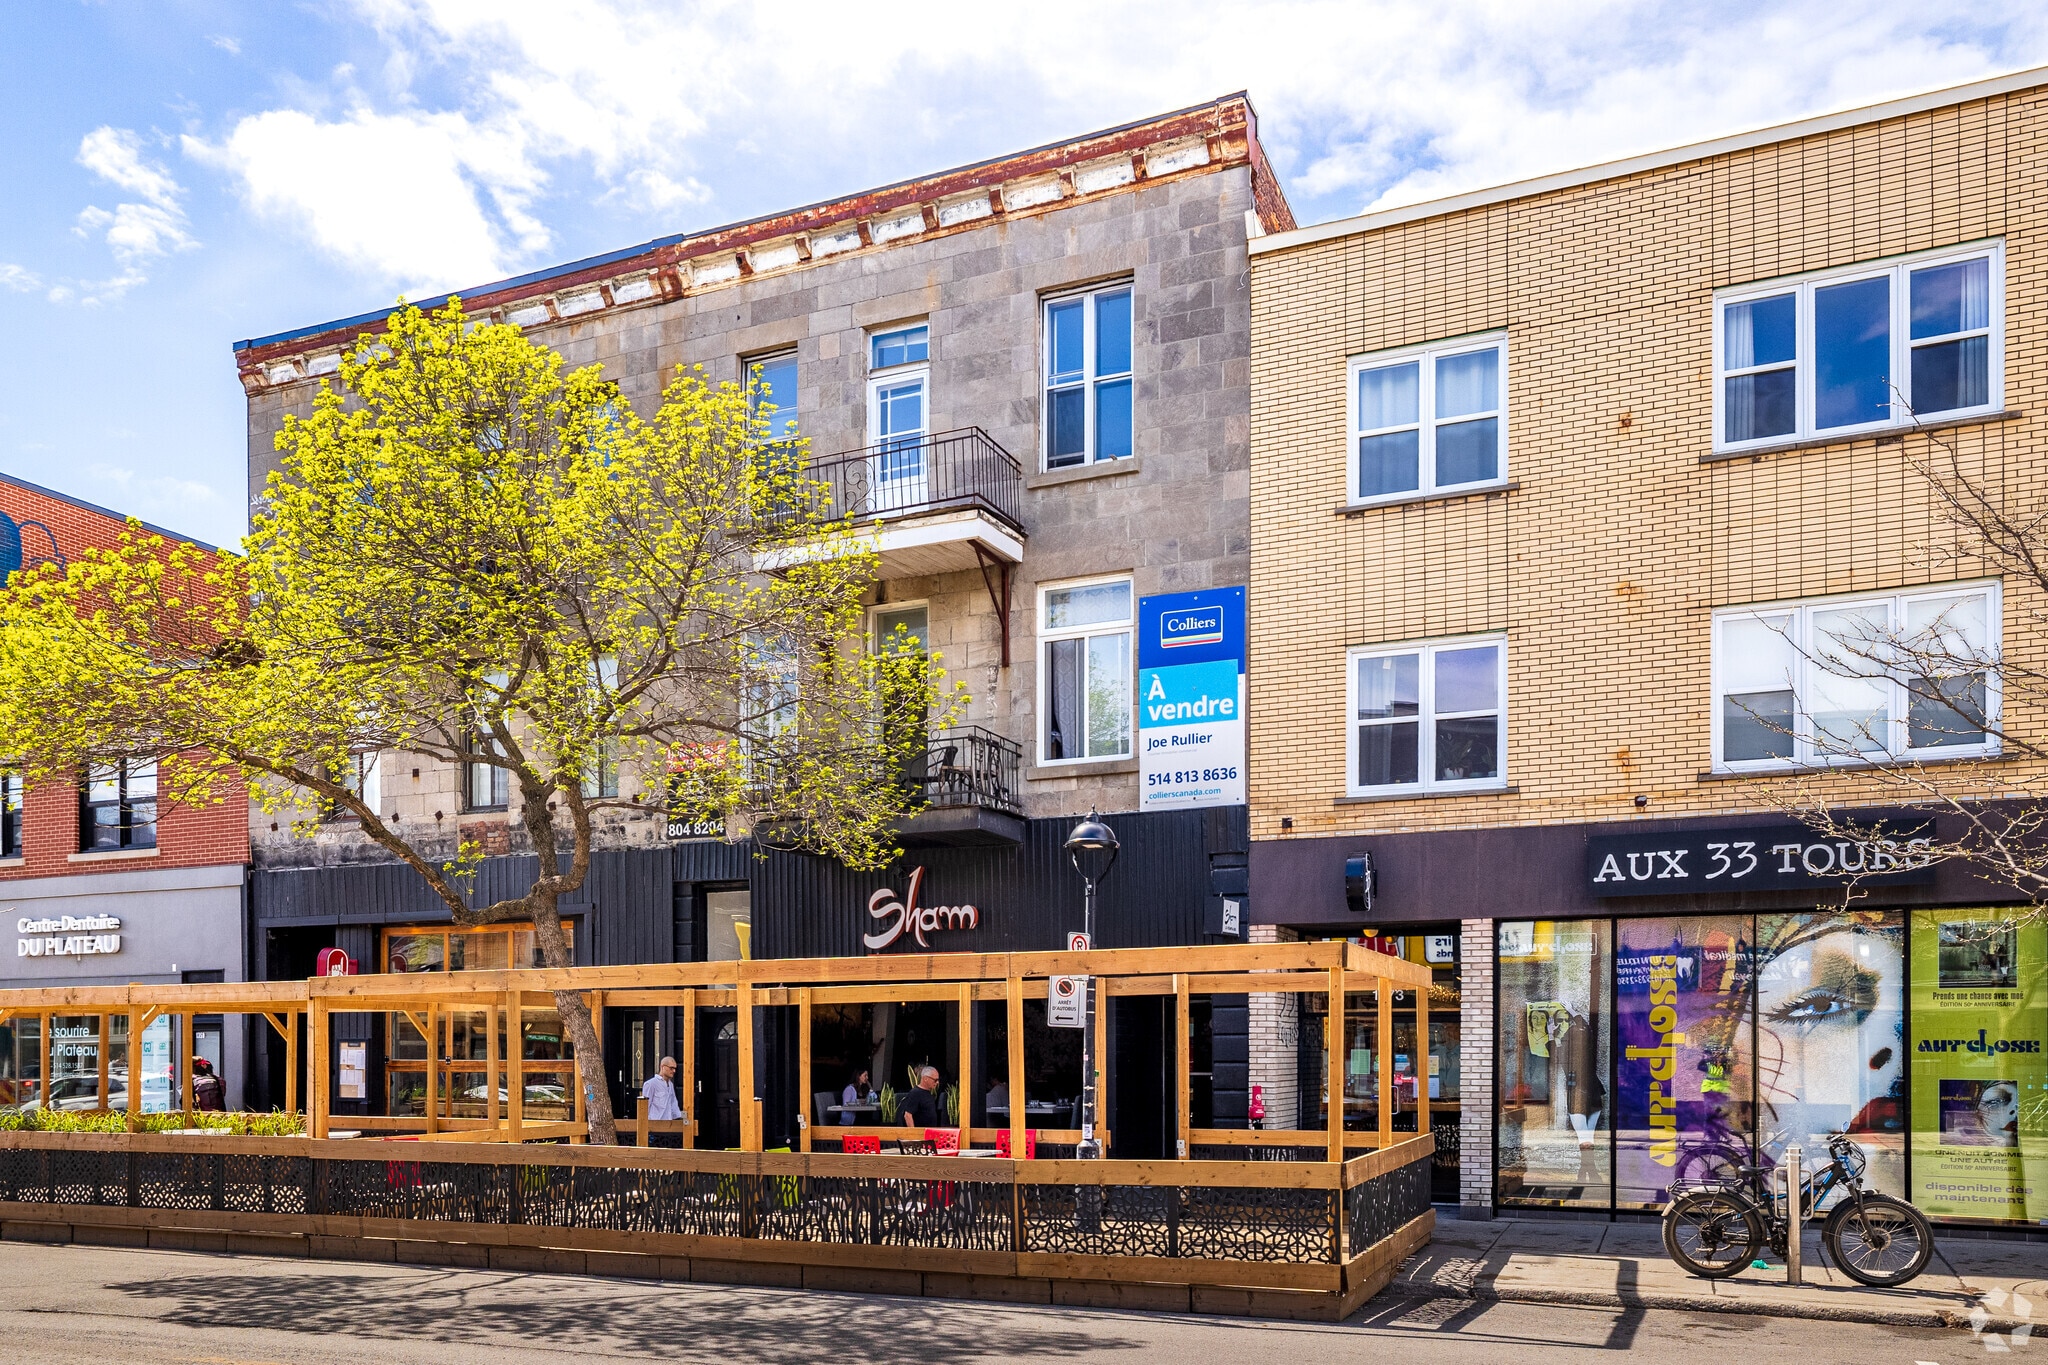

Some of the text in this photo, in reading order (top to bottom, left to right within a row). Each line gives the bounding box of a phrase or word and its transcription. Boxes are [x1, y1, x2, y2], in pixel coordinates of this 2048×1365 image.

[1167, 617, 1216, 632] Colliers
[1147, 673, 1166, 701] À
[1147, 695, 1234, 722] vendre
[1147, 733, 1213, 752] Joe Rullier
[1148, 766, 1237, 786] 514 813 8636
[1148, 787, 1222, 800] collierscanada.com
[668, 823, 691, 837] 804
[1593, 838, 1931, 883] AUX 33 TOURS
[863, 865, 979, 949] Sham
[17, 913, 121, 934] Centre Dentaire
[18, 934, 121, 957] DU PLATEAU
[1932, 991, 1955, 1001] Prends
[1956, 992, 1968, 1001] une
[1969, 991, 1993, 1001] chance
[1993, 992, 2009, 1001] avec
[55, 1025, 90, 1038] sourire
[57, 1043, 98, 1057] Plateau
[1925, 1182, 2033, 1195] disponible dès
[1934, 1194, 2025, 1204] maintenant
